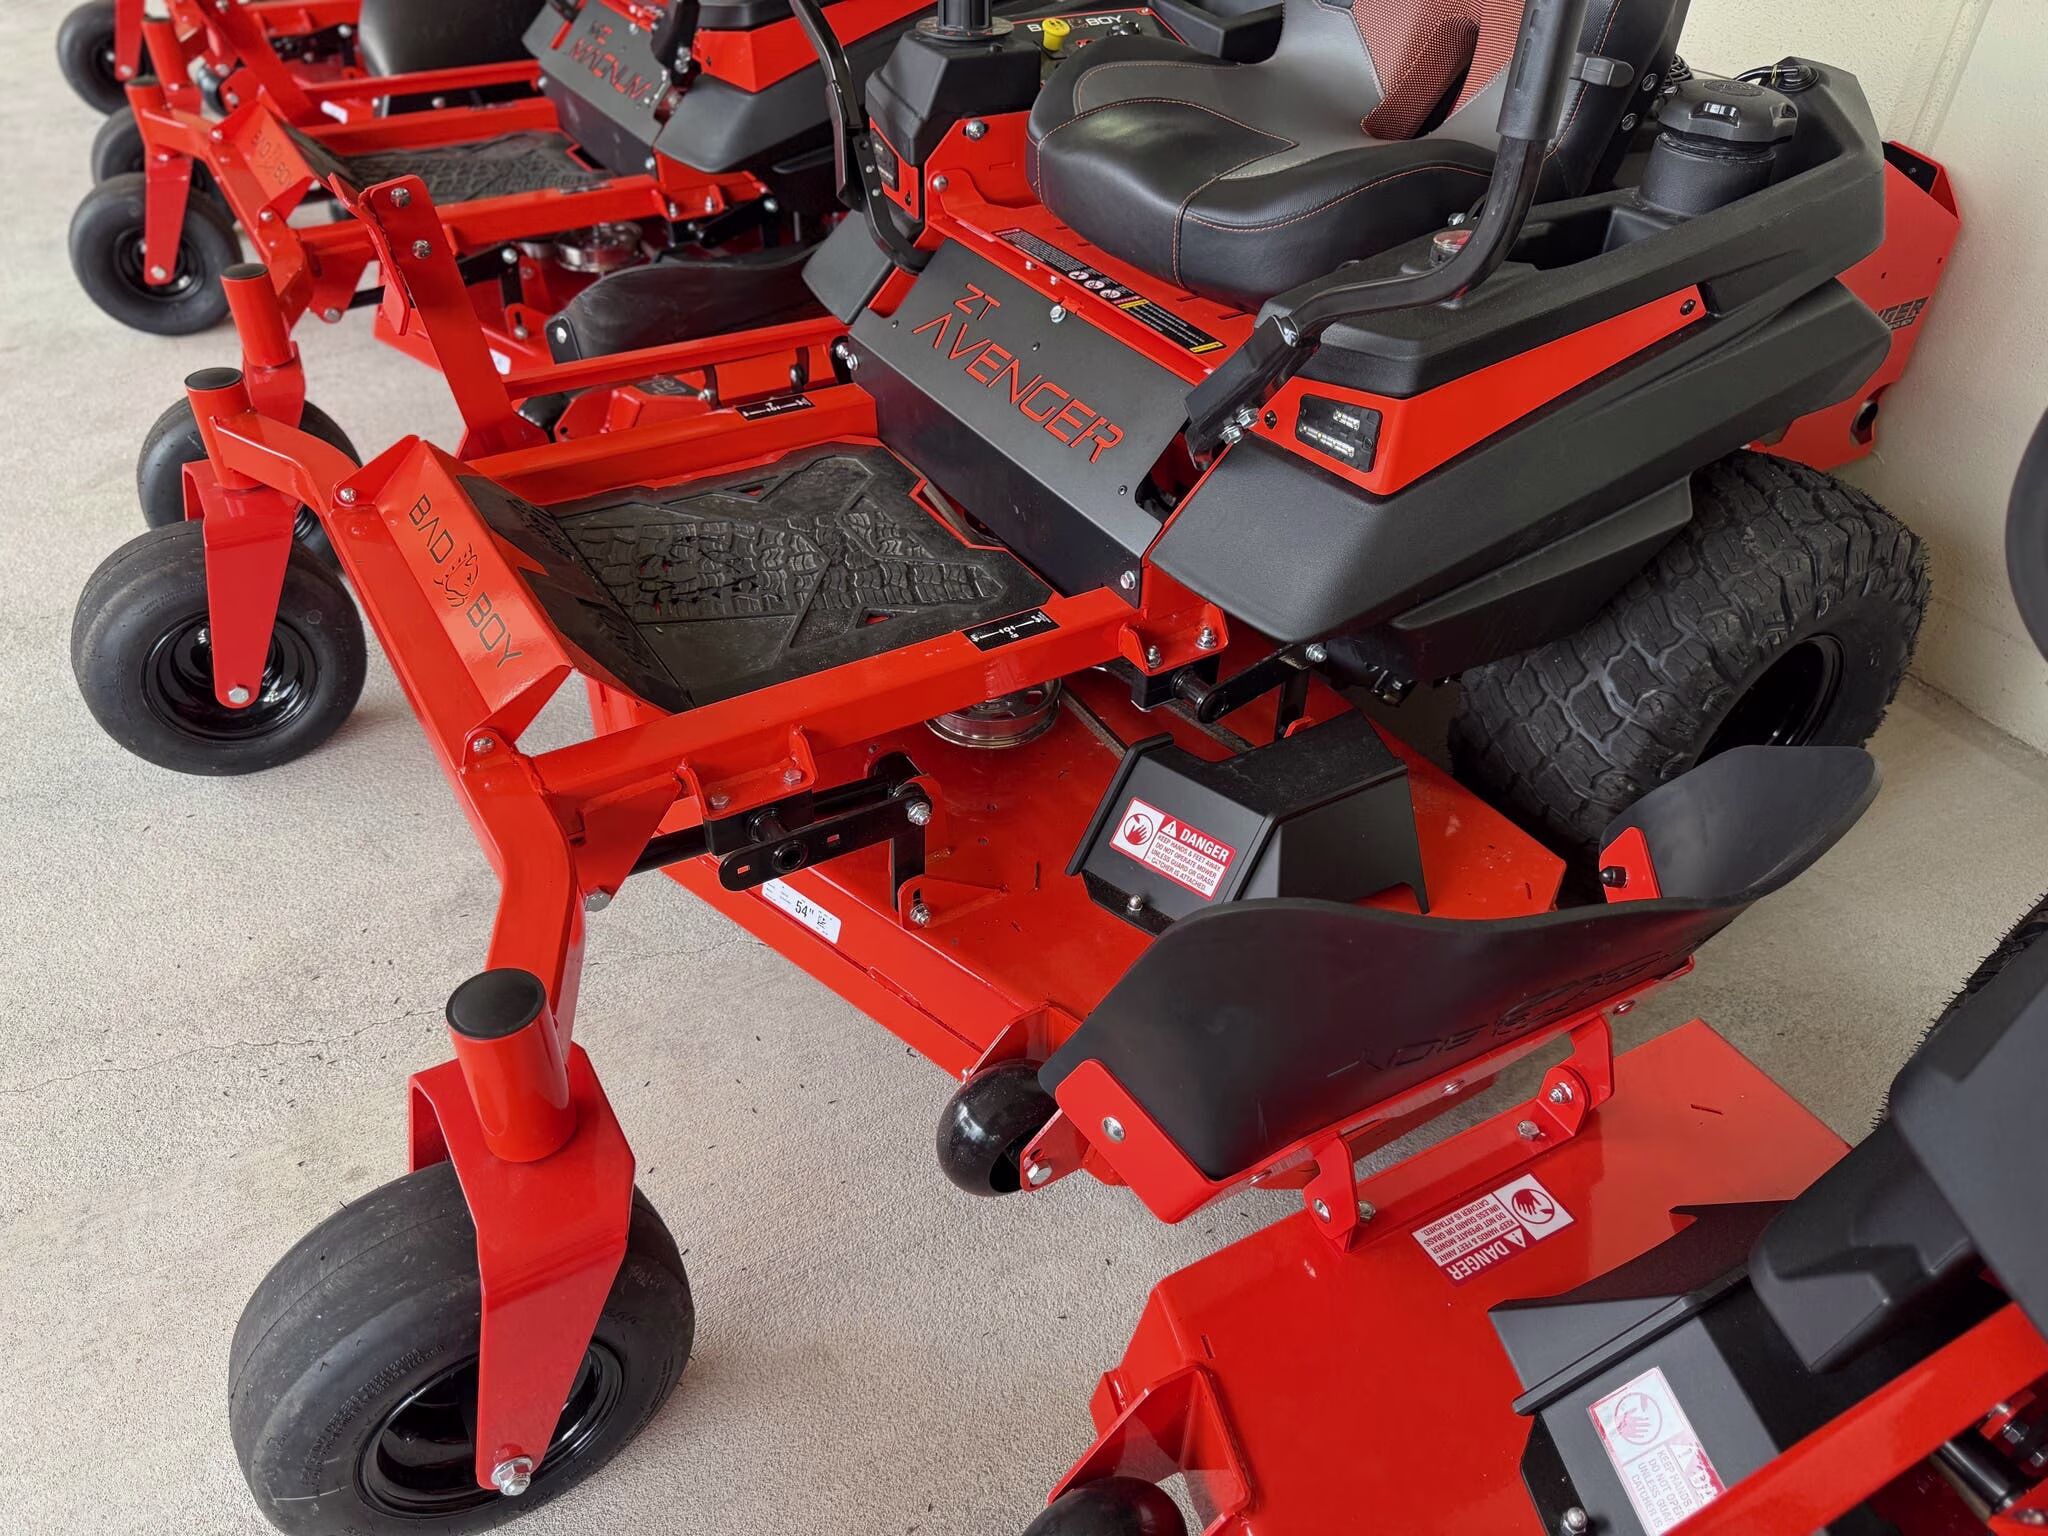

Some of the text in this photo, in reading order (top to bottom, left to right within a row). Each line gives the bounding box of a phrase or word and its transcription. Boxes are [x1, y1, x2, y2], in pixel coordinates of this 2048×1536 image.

[1085, 15, 1122, 26] BOY
[953, 282, 1001, 321] ZT
[912, 312, 1125, 464] AVENGER
[408, 493, 523, 669] BAD BOY
[1155, 842, 1217, 880] DO NOT OPERATE MOWER
[1157, 834, 1171, 844] KEEP
[1170, 841, 1188, 854] HANDS
[1188, 850, 1193, 858] &
[1192, 853, 1206, 864] FEET
[1180, 828, 1230, 863] DANGER
[1151, 849, 1215, 887] UNLESS GUARD OR GRASS
[1174, 869, 1180, 877] IS
[1453, 1212, 1462, 1220] IS
[1460, 1199, 1490, 1216] CATCHER
[1423, 1204, 1501, 1248] UNLESS GUARD OR GRASS
[1431, 1212, 1507, 1254] DO NOT OPERATE MOWER
[1470, 1237, 1479, 1245] &
[1476, 1226, 1500, 1242] HANDS
[1498, 1219, 1516, 1232] KEEP
[1446, 1240, 1511, 1281] DANGER
[1456, 1240, 1473, 1253] FEET
[1638, 1462, 1660, 1498] UNLESS
[1648, 1458, 1660, 1472] DO
[1656, 1473, 1672, 1492] NOT
[1657, 1450, 1692, 1508] KEEP HANDS
[1632, 1474, 1664, 1528] CATCHER IS
